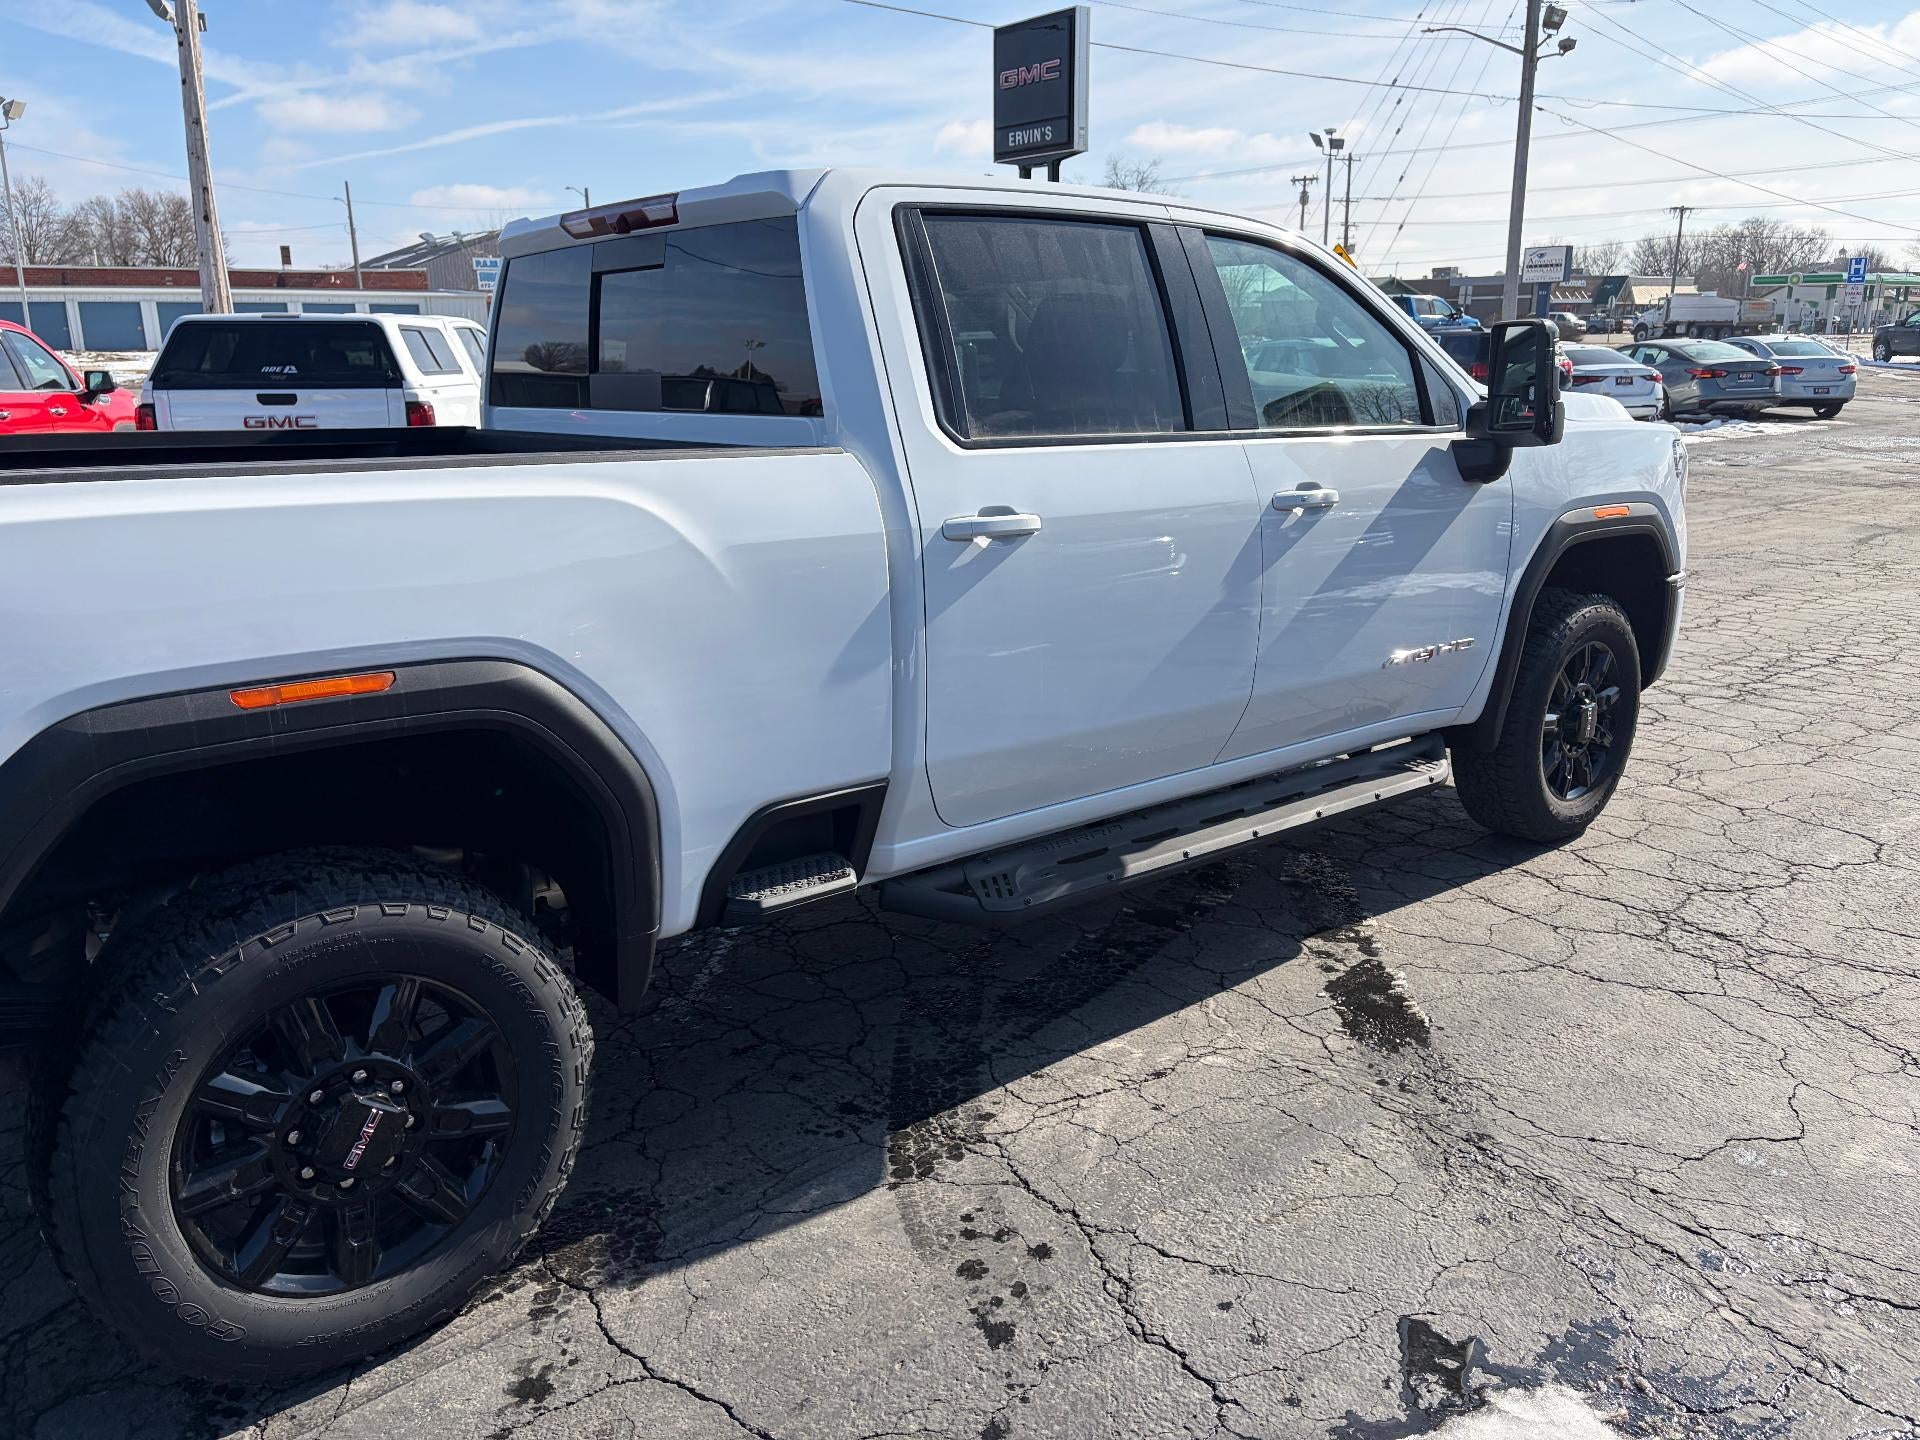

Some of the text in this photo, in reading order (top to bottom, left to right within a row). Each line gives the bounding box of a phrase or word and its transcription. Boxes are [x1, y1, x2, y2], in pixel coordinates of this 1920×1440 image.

[999, 58, 1061, 90] GMC
[1008, 126, 1052, 147] ERVIN'S
[1850, 258, 1866, 275] H
[243, 415, 319, 429] GMC
[1031, 824, 1125, 856] SIERRA
[343, 1108, 384, 1170] GMC
[119, 1048, 248, 1342] GOODYEAR
